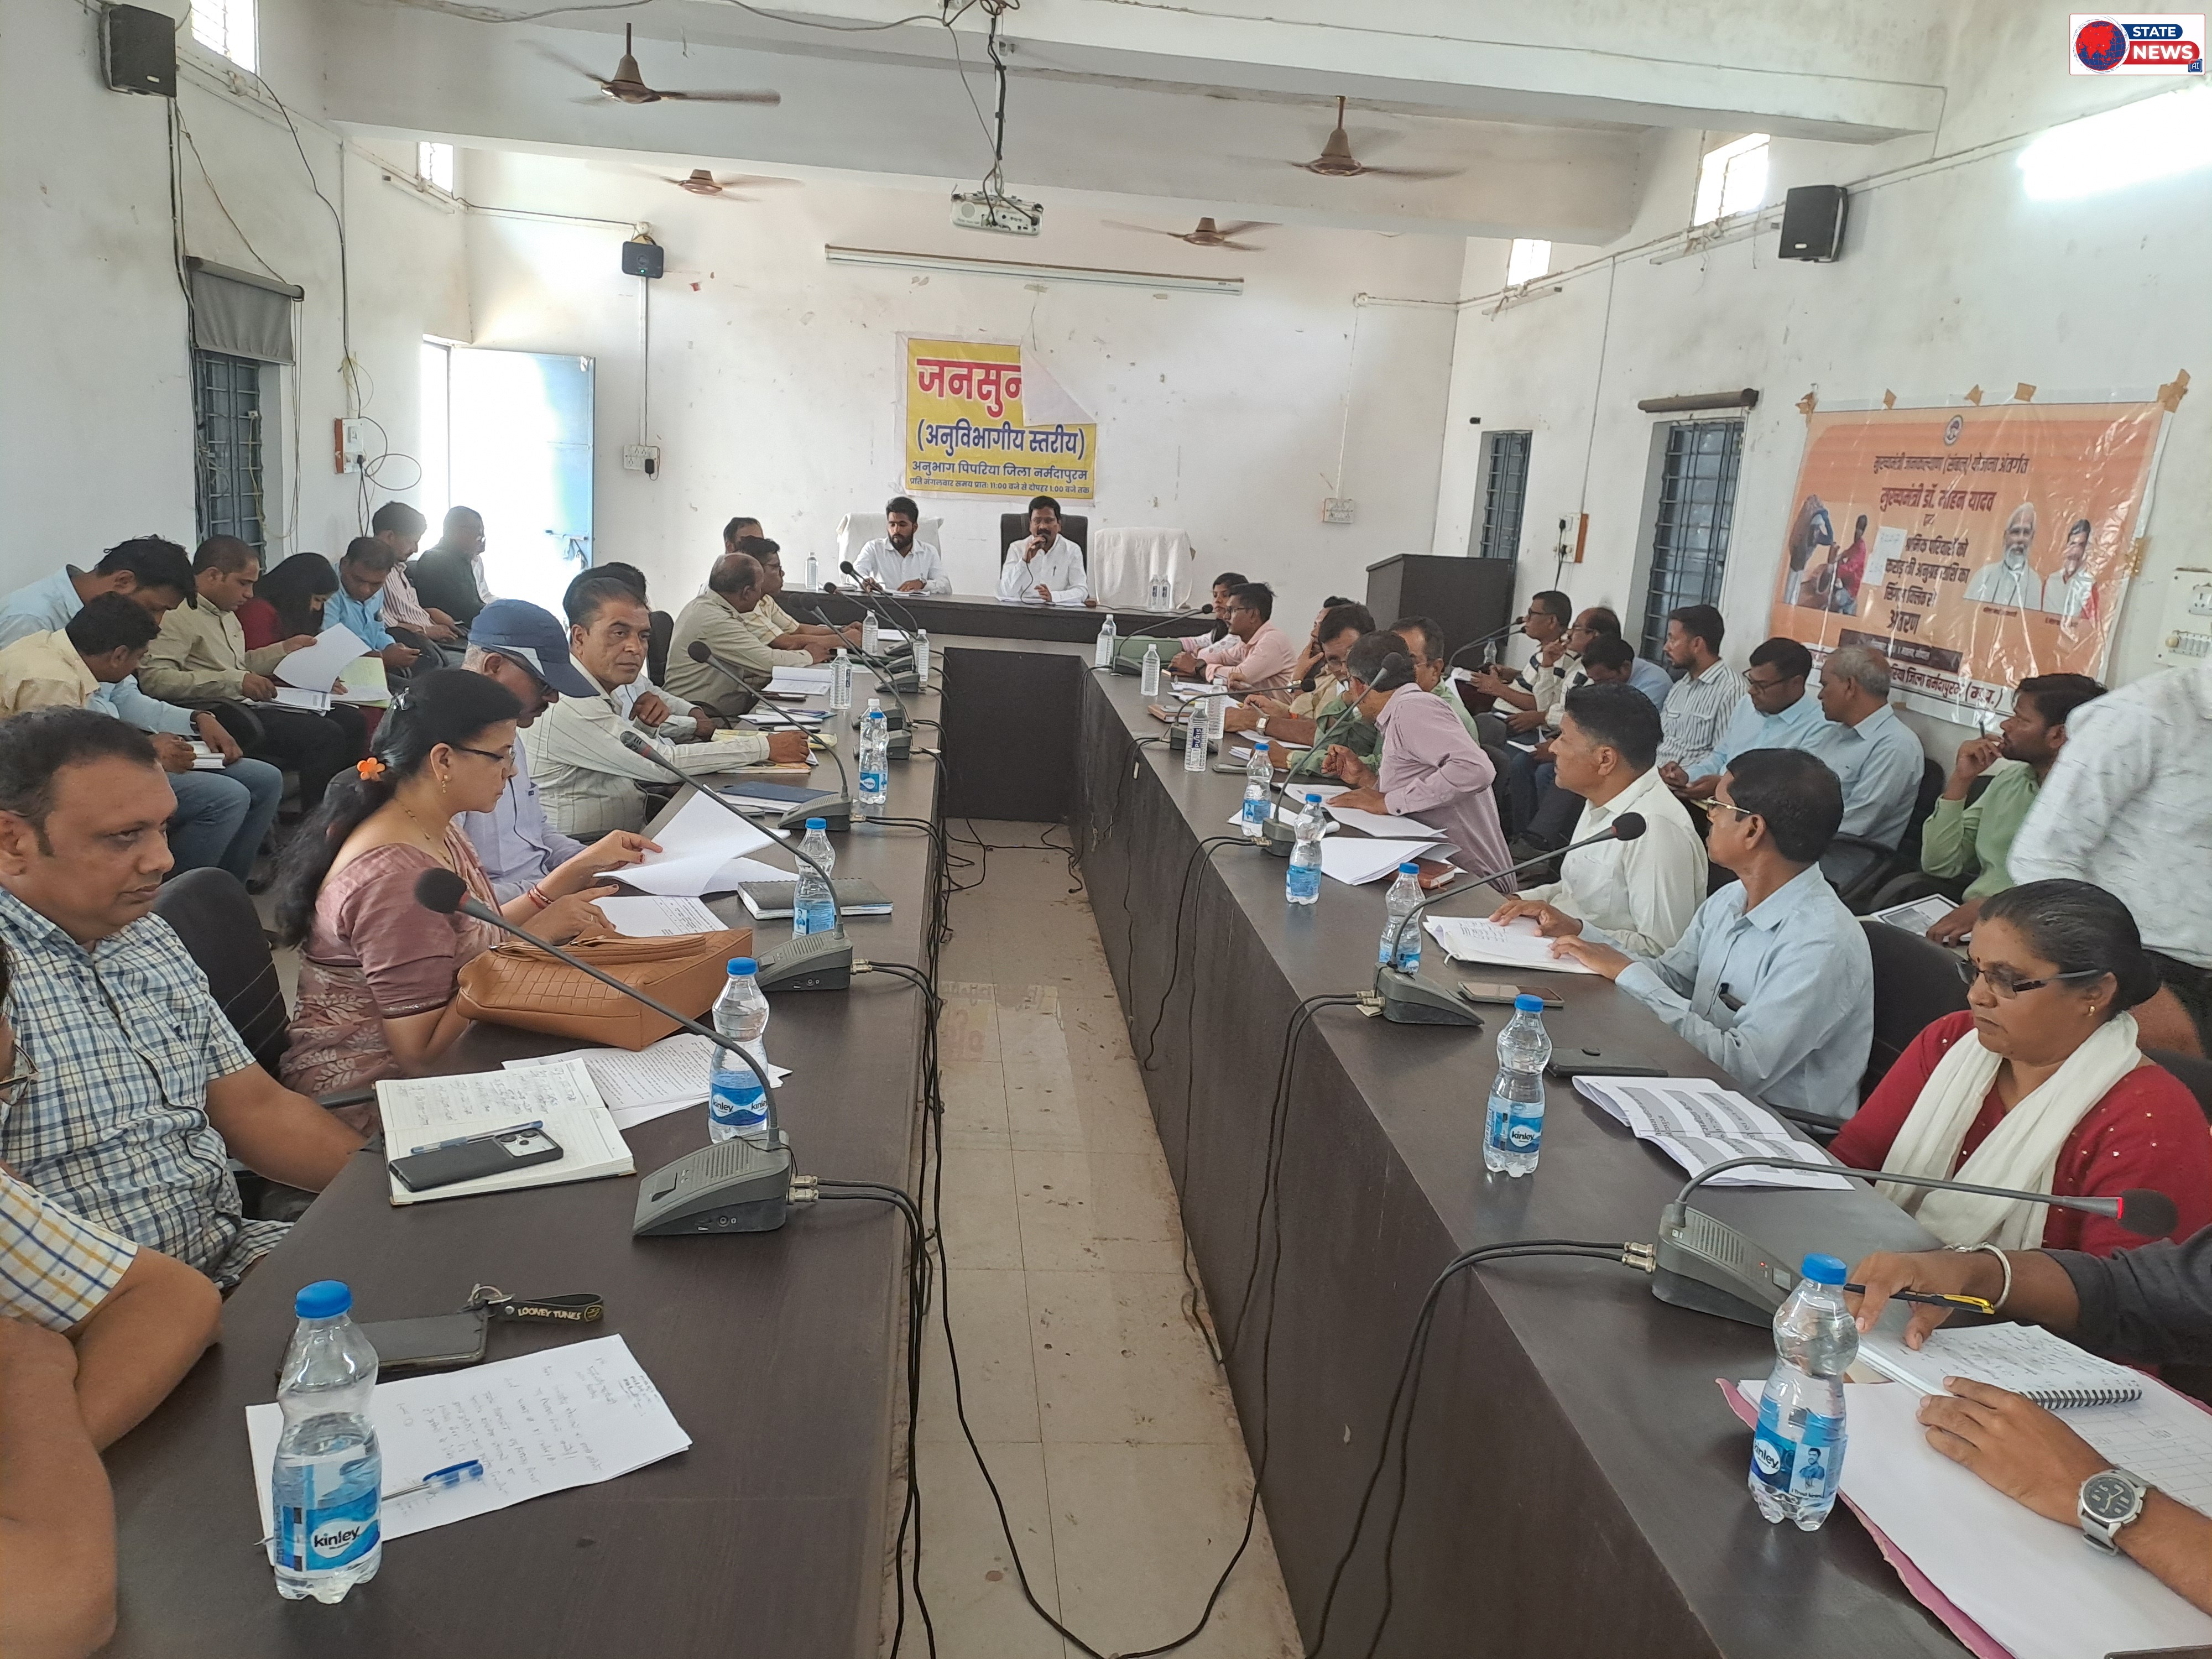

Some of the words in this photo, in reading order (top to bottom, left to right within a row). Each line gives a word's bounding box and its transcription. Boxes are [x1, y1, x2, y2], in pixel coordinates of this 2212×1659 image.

[918, 418, 1025, 456] (अनुविभागीय
[1029, 424, 1084, 460] स्तरीय)
[912, 461, 955, 475] अनुभाग
[958, 460, 1000, 476] पिपरिया
[1003, 462, 1031, 477] जिला
[1034, 465, 1088, 483] नर्मदापुरम
[910, 477, 922, 485] प्रति
[924, 477, 953, 486] मंगलवार
[1021, 482, 1027, 491] से
[1029, 483, 1048, 492] दोपहर
[1968, 491, 1997, 512] यादव
[1906, 667, 1924, 687] जिला
[713, 1099, 734, 1112] kinley
[1512, 1131, 1535, 1141] kinley
[518, 1307, 552, 1317] LOONEY
[553, 1310, 582, 1320] TUNES
[314, 1526, 361, 1547] kinley
